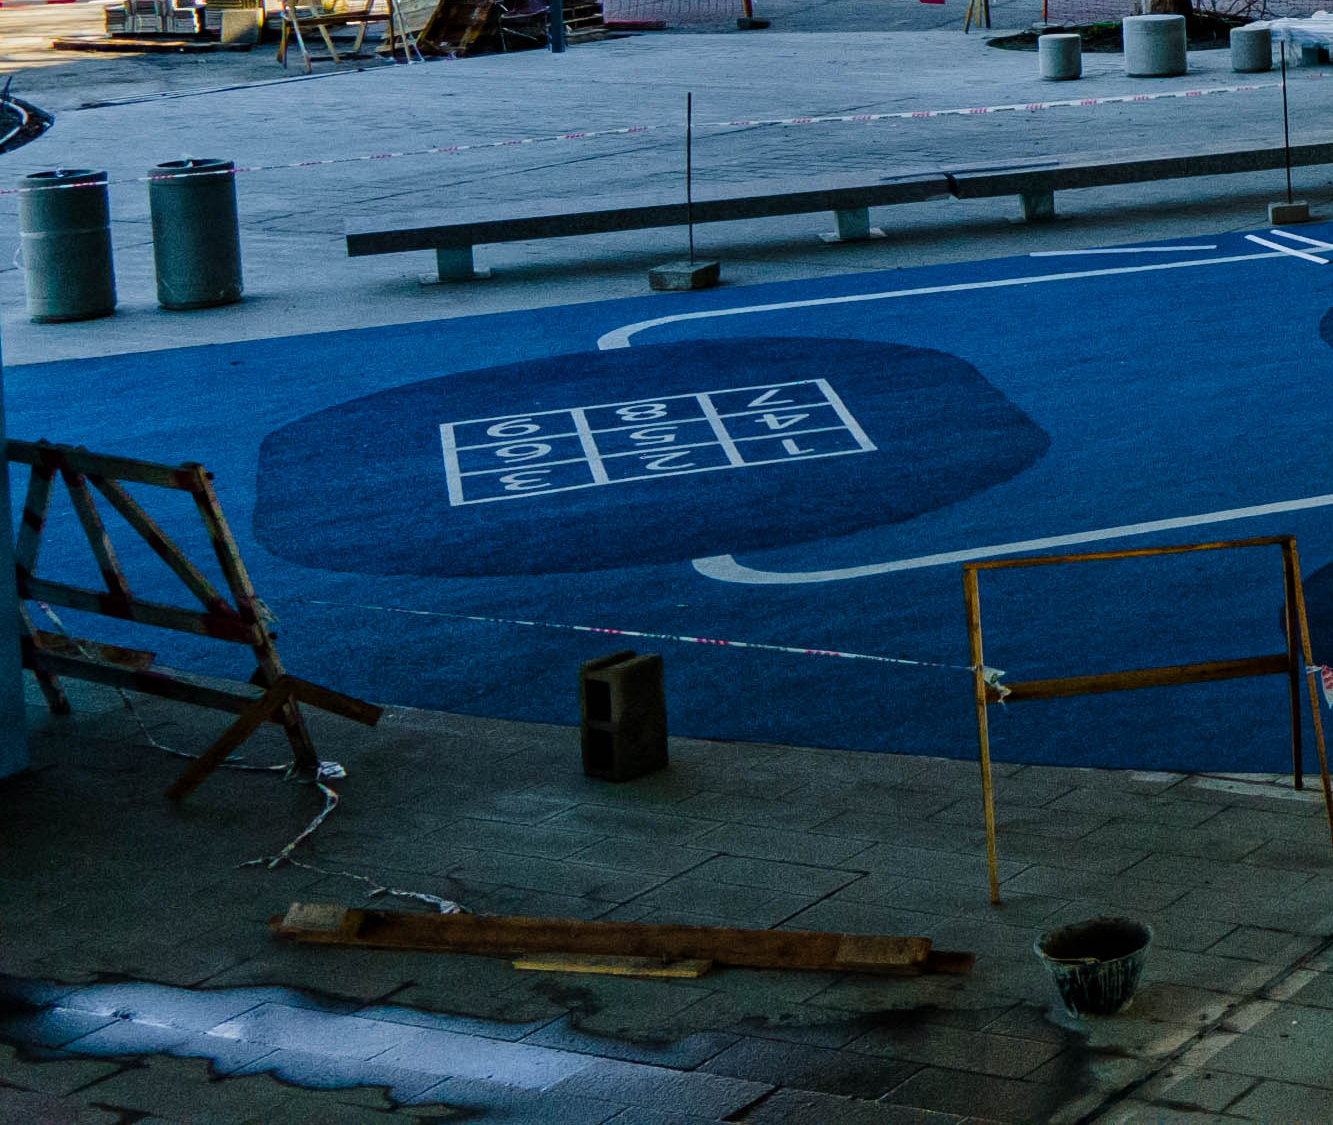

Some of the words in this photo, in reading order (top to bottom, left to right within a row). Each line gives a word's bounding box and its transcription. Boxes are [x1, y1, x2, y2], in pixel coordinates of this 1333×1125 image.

[487, 418, 540, 437] 9
[616, 403, 668, 421] 8
[747, 389, 794, 407] 7
[496, 443, 552, 463] 6
[629, 426, 678, 446] 5
[754, 414, 810, 430] 4
[499, 469, 552, 490] 3
[640, 450, 696, 470] 2
[782, 438, 815, 455] 1
